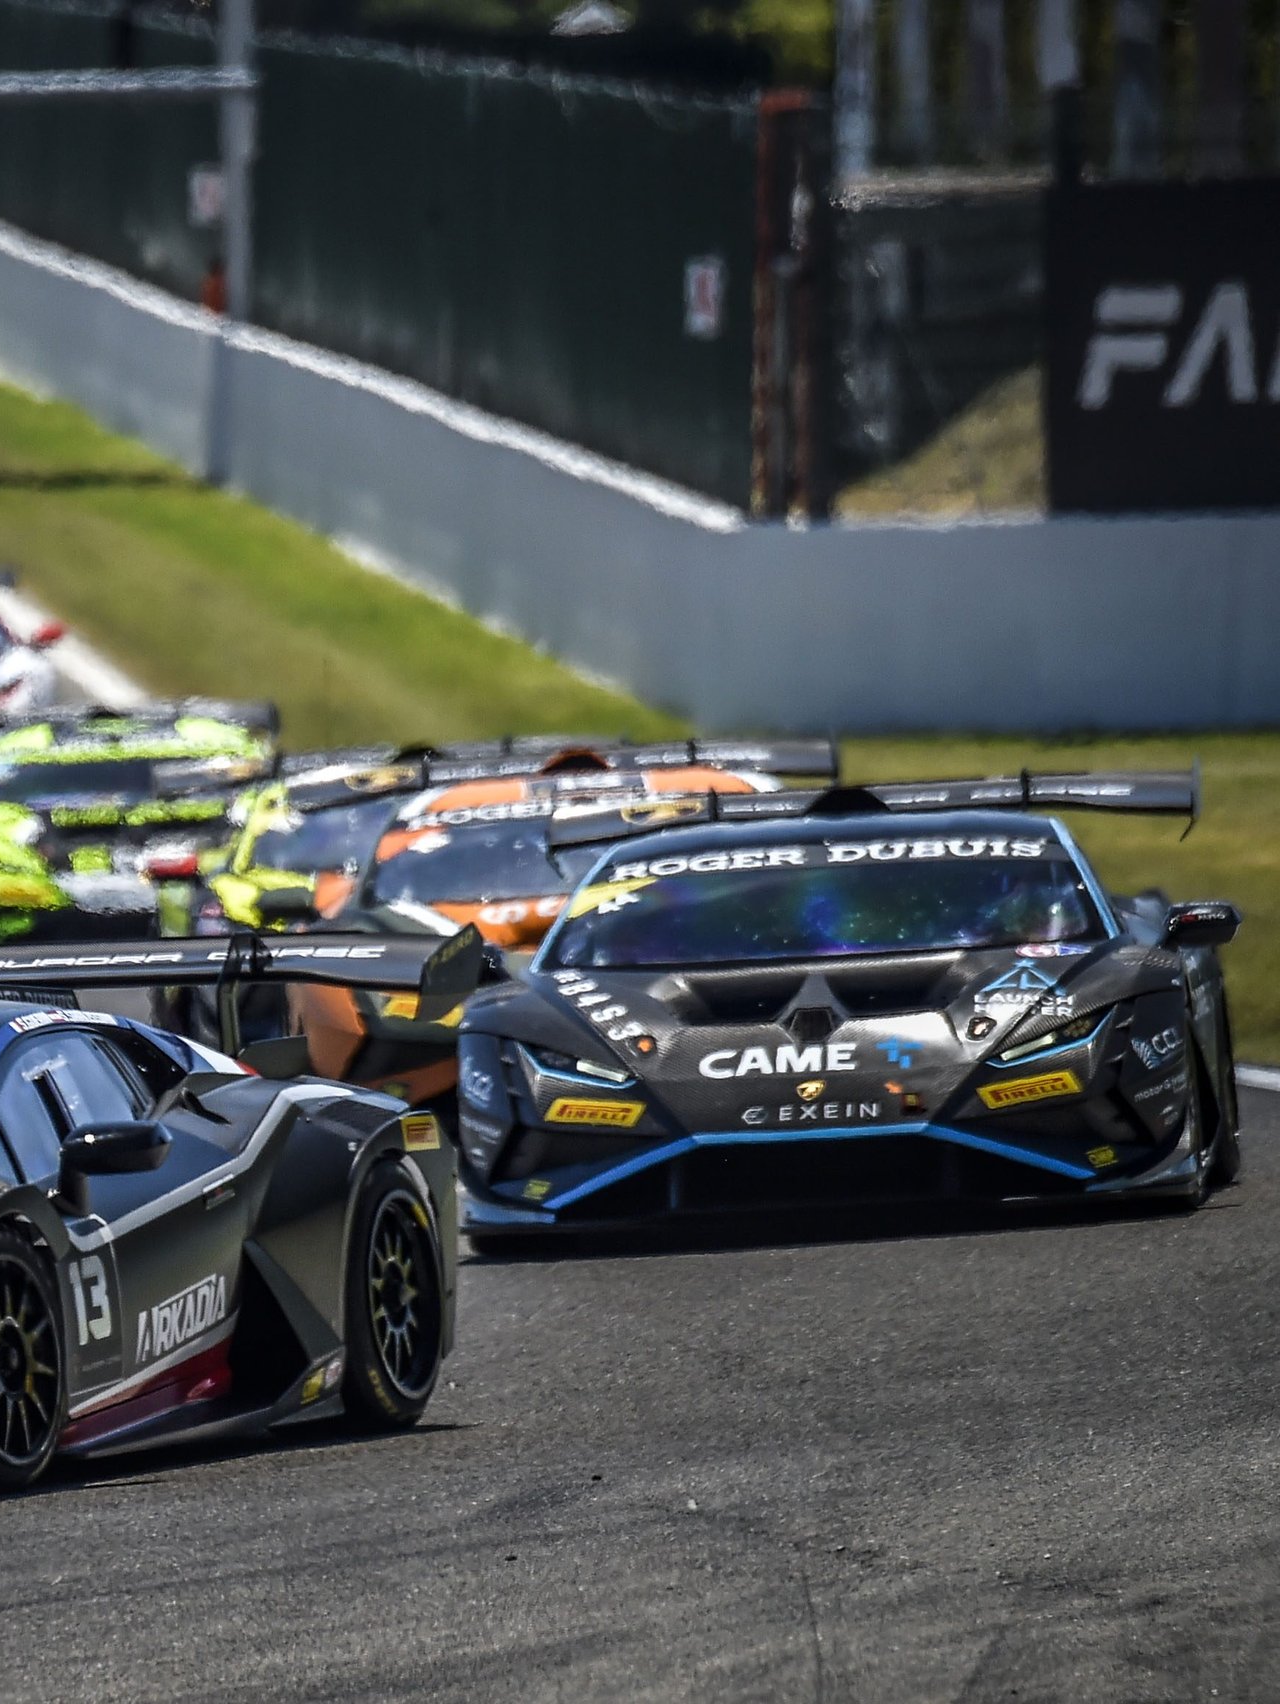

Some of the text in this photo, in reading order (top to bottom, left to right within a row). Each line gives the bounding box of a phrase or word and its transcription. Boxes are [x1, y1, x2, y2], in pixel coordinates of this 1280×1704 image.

[1077, 283, 1280, 410] FA
[609, 838, 1047, 882] ROGER DUBUIS
[207, 945, 387, 961] CRSE
[699, 1043, 857, 1079] CAME
[989, 1077, 1070, 1103] PIRELLI
[556, 1104, 632, 1123] PIRELLI
[778, 1103, 880, 1121] EXEIN
[69, 1256, 112, 1346] 13
[136, 1273, 226, 1364] ARKADIA
